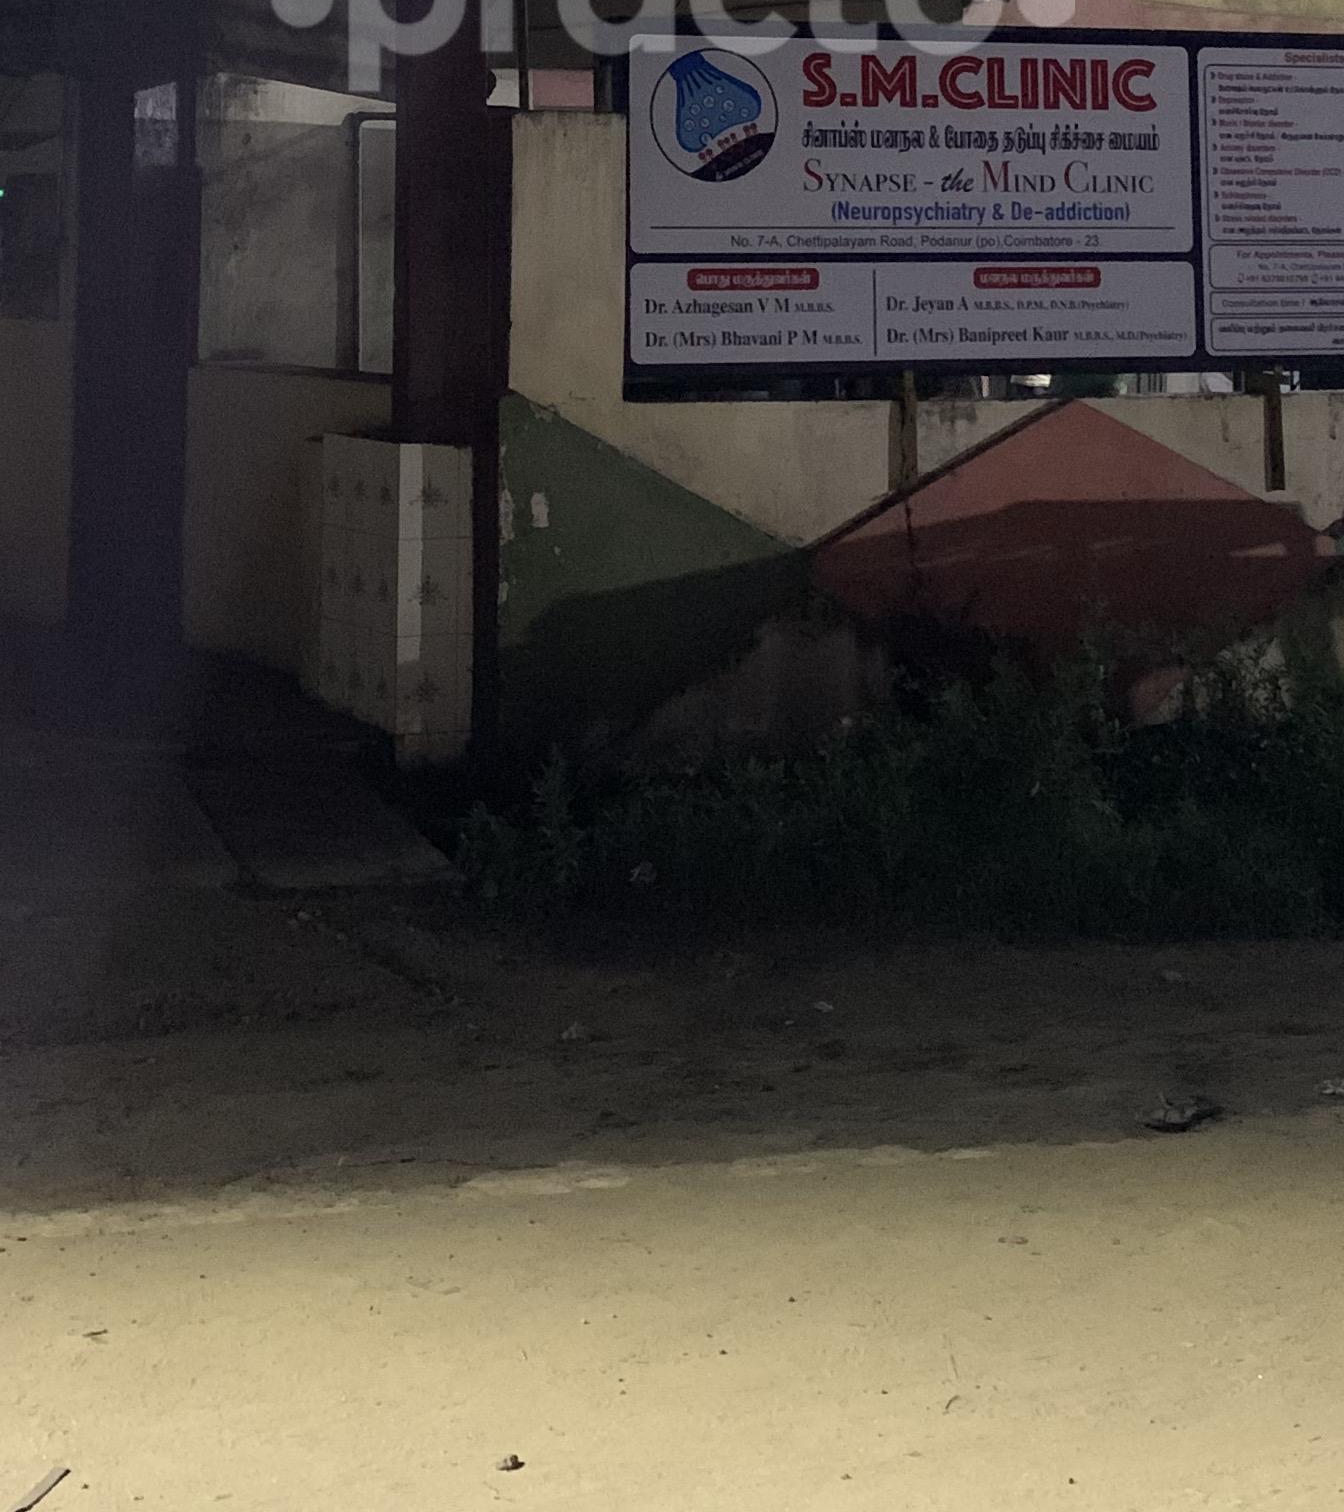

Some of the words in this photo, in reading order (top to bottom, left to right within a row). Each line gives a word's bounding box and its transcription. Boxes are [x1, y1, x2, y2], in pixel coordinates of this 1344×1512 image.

[1284, 52, 1344, 64] Specialists
[801, 51, 1158, 112] S.M.CLINIC
[801, 120, 867, 149] சினாப்ஸ்
[870, 128, 925, 154] மனநல
[929, 124, 941, 150] &
[944, 124, 1000, 154] போதை
[1002, 123, 1046, 155] தடுப்பு
[1049, 123, 1105, 152] சிகிச்சை
[1108, 123, 1161, 152] மையம்
[939, 174, 975, 194] the
[831, 201, 986, 225] (Neuropsychiatry
[992, 203, 1005, 222] &
[1010, 201, 1131, 224] De-addiction)
[1084, 234, 1100, 247] 23
[644, 298, 669, 315] Dr.
[671, 297, 753, 317] Azhagesan
[757, 297, 770, 313] V
[774, 297, 790, 313] M
[886, 295, 909, 312] Dr.
[911, 295, 955, 315] Jeyan
[957, 296, 970, 311] A
[644, 331, 669, 348] Dr.
[672, 330, 717, 349] (Mrs)
[721, 330, 783, 347] Bhavani
[786, 330, 799, 346] P
[802, 329, 818, 345] M
[886, 327, 909, 344] Dr.
[912, 327, 954, 345] (Mrs)
[958, 326, 1028, 346] Banipreet
[1031, 326, 1069, 342] Kaur
